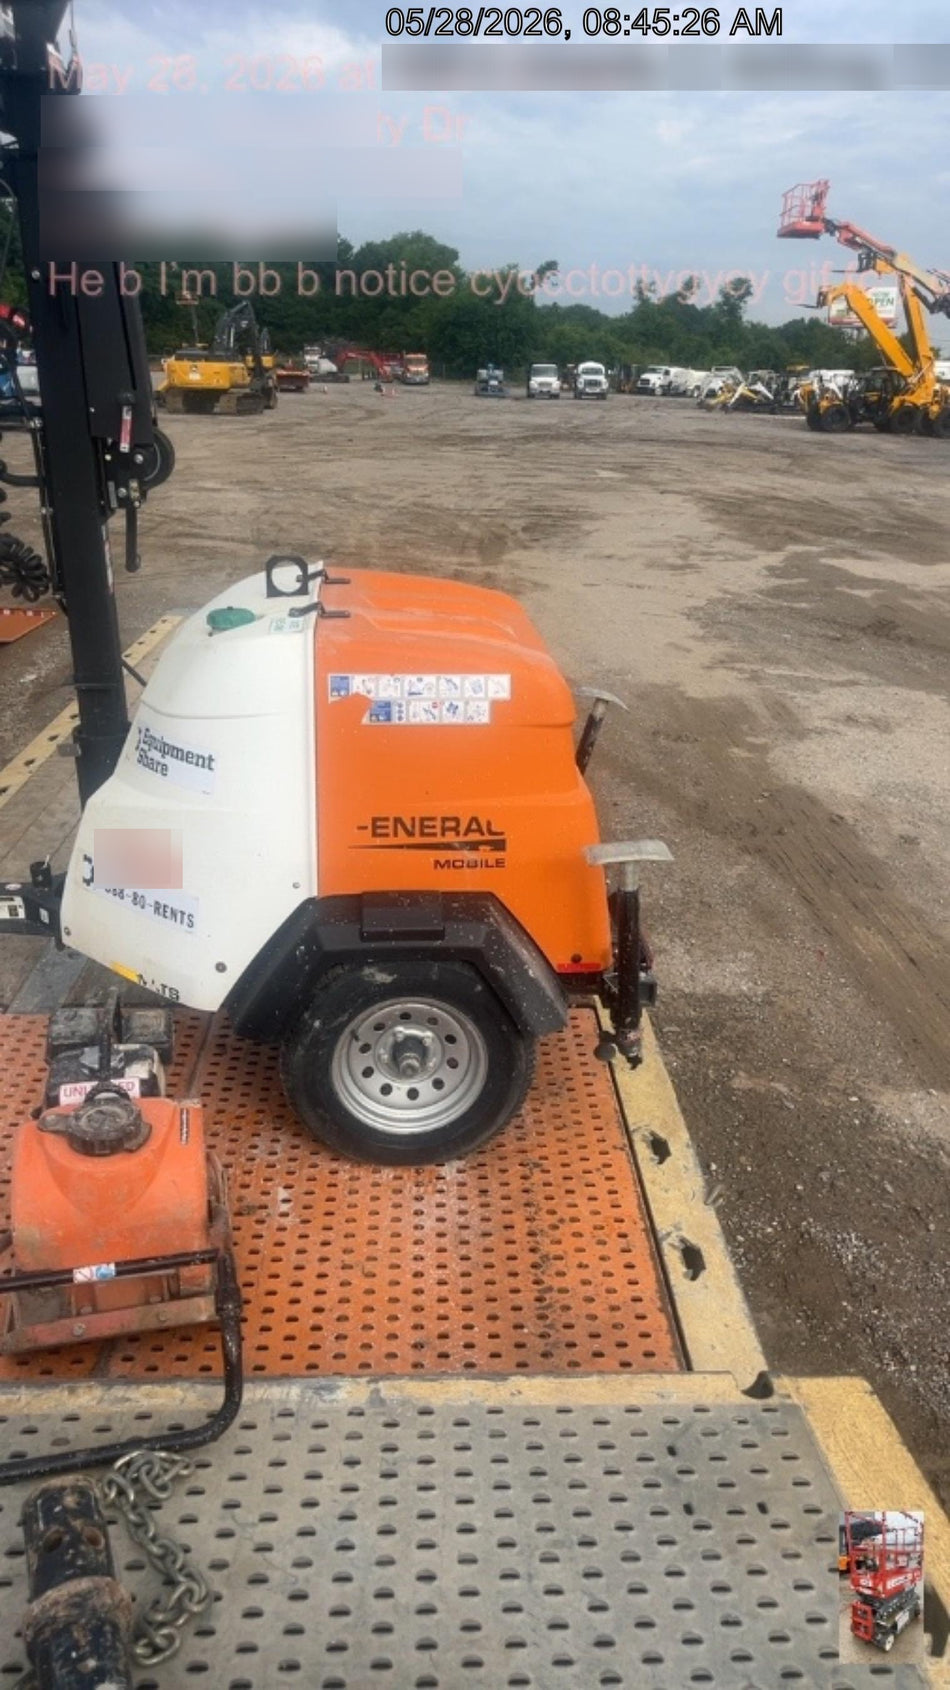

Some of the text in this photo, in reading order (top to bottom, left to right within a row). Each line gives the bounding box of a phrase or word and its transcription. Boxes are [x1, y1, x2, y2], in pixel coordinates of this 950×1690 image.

[138, 747, 168, 776] Share
[143, 727, 215, 771] Equipment
[357, 816, 505, 838] ENERAL
[434, 858, 505, 870] MOBILE
